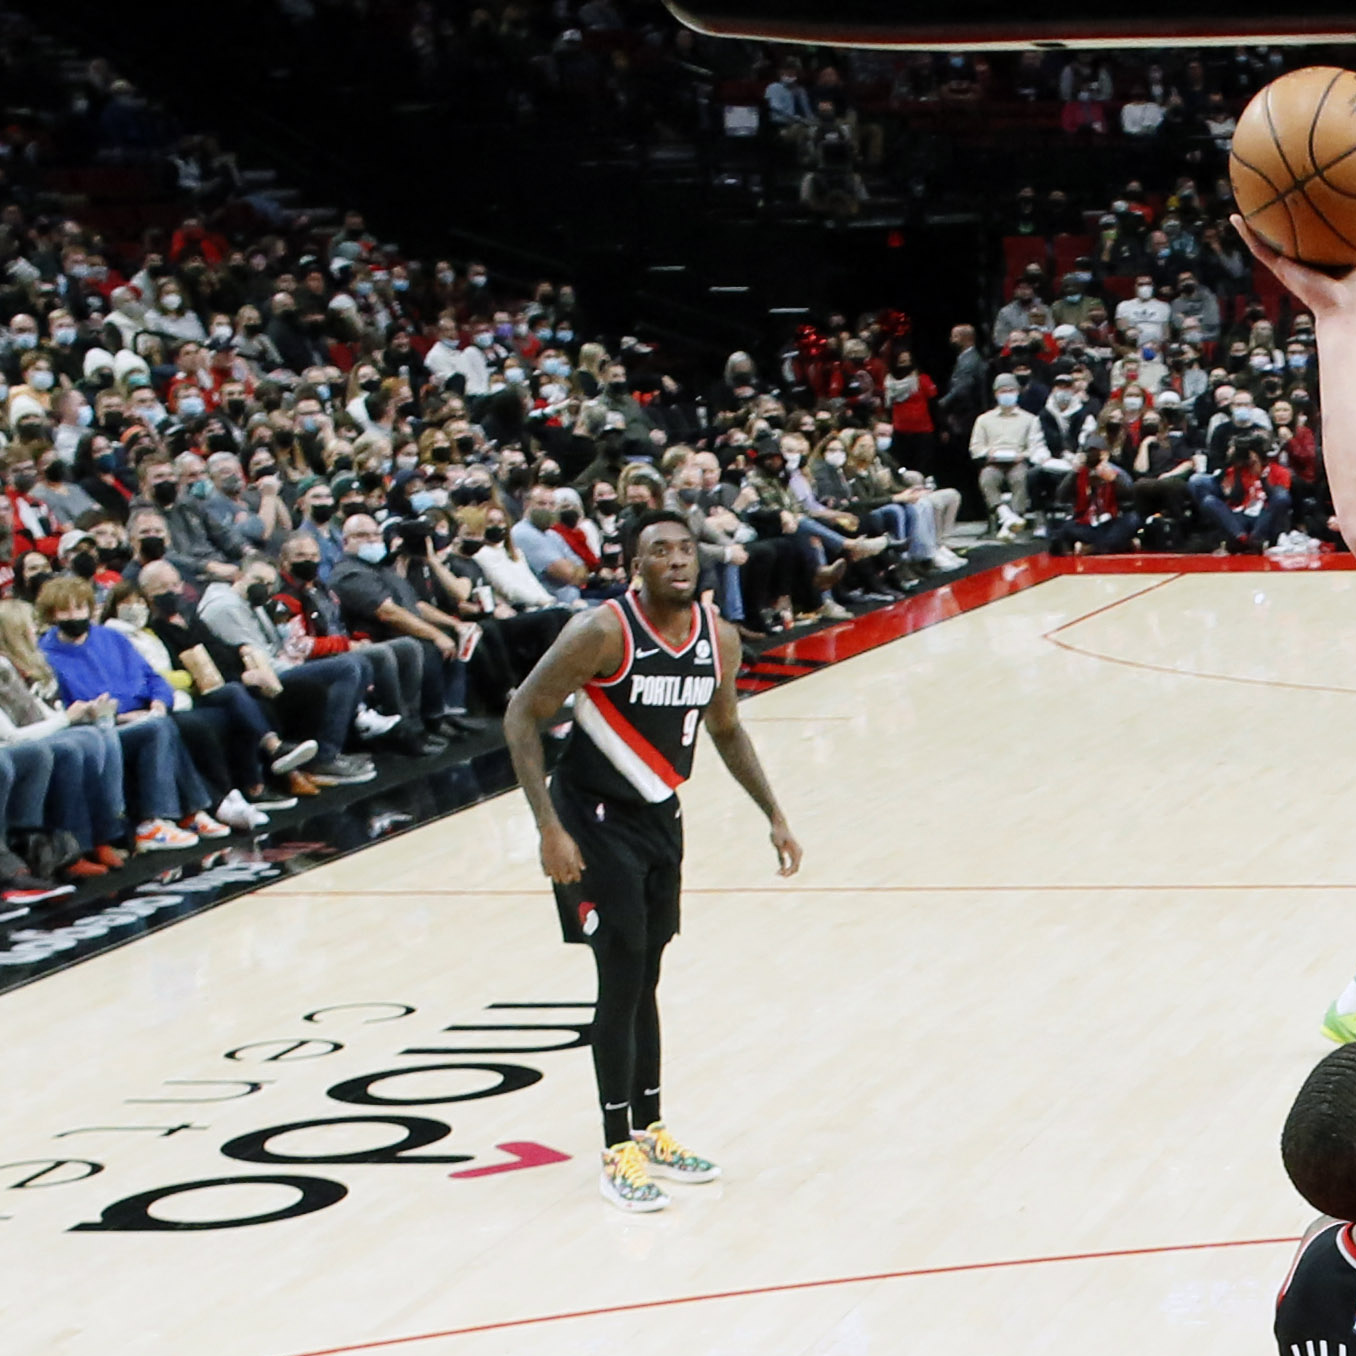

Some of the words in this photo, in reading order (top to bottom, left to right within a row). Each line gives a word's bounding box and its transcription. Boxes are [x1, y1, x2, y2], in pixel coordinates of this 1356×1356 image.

[629, 674, 715, 707] PORTLAND
[681, 709, 700, 746] 9
[0, 1002, 416, 1219] cente
[66, 1001, 598, 1232] moda
